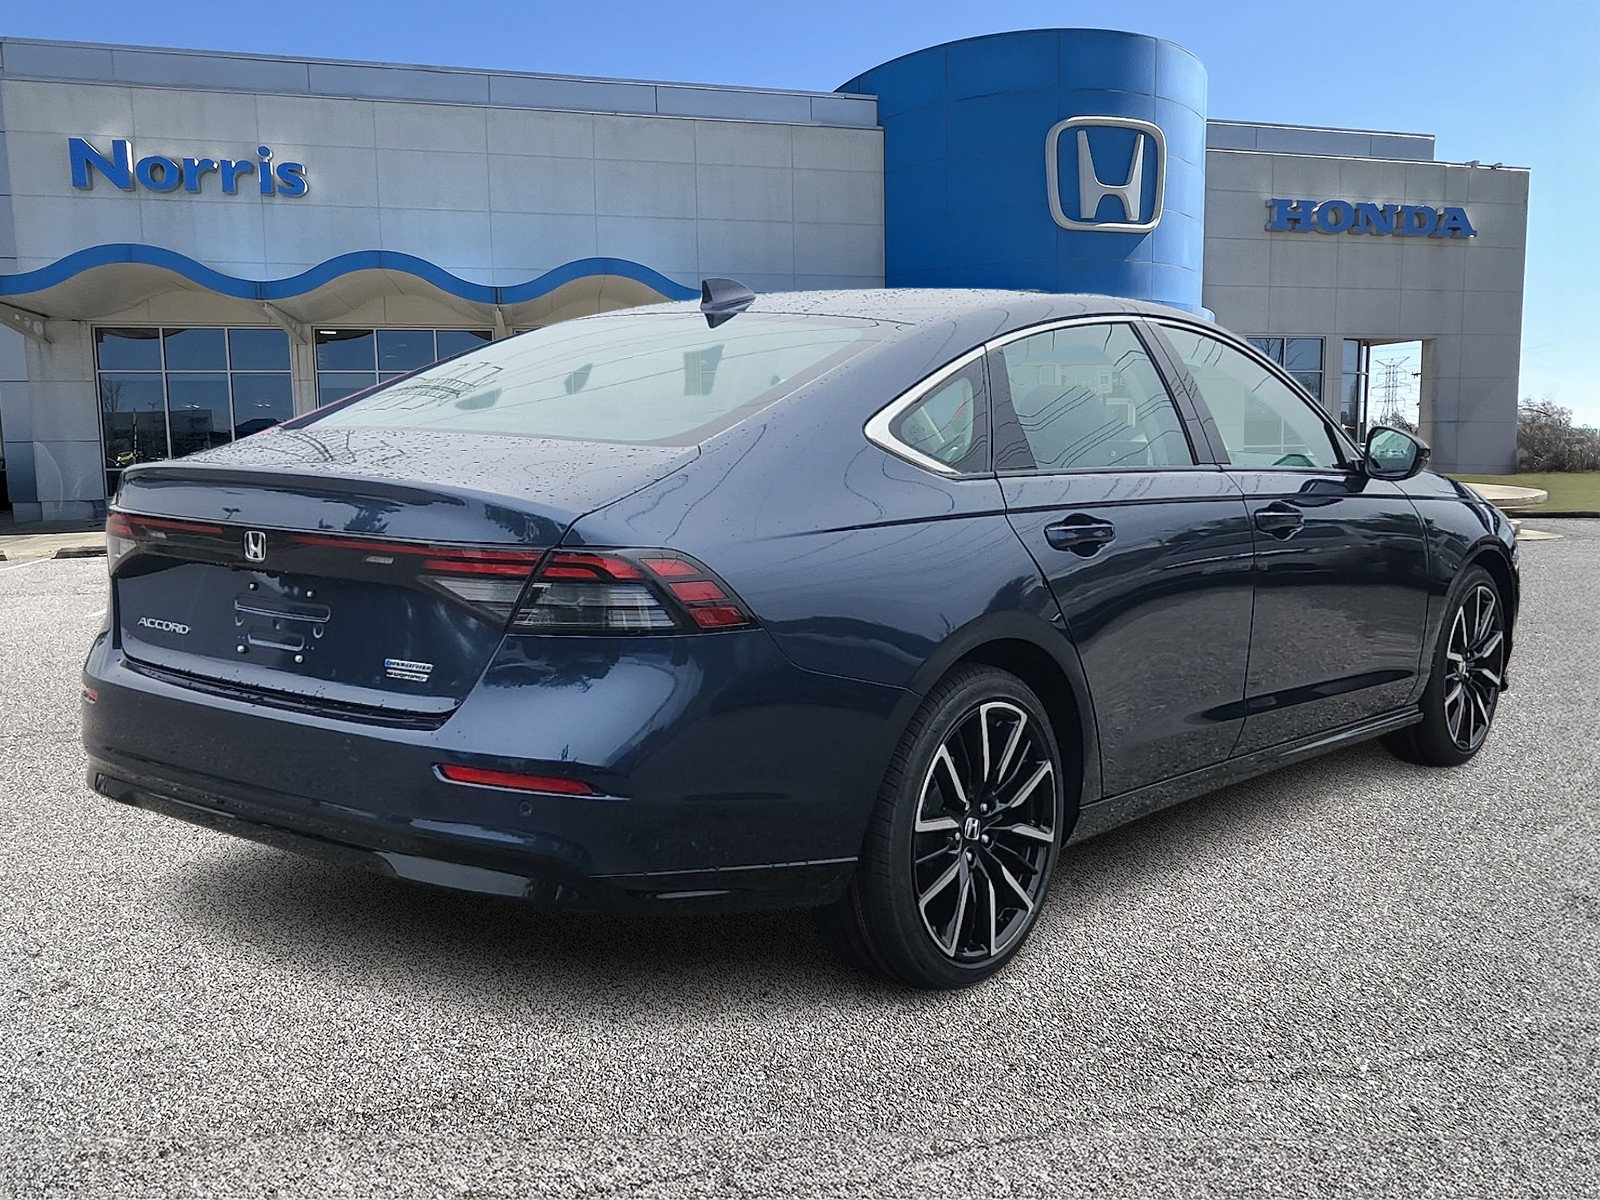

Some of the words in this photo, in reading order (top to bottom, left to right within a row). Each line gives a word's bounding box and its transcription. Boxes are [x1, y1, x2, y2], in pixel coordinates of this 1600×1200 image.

[68, 137, 308, 198] Norris
[1266, 198, 1478, 239] HONDA
[137, 616, 190, 635] ACCORD
